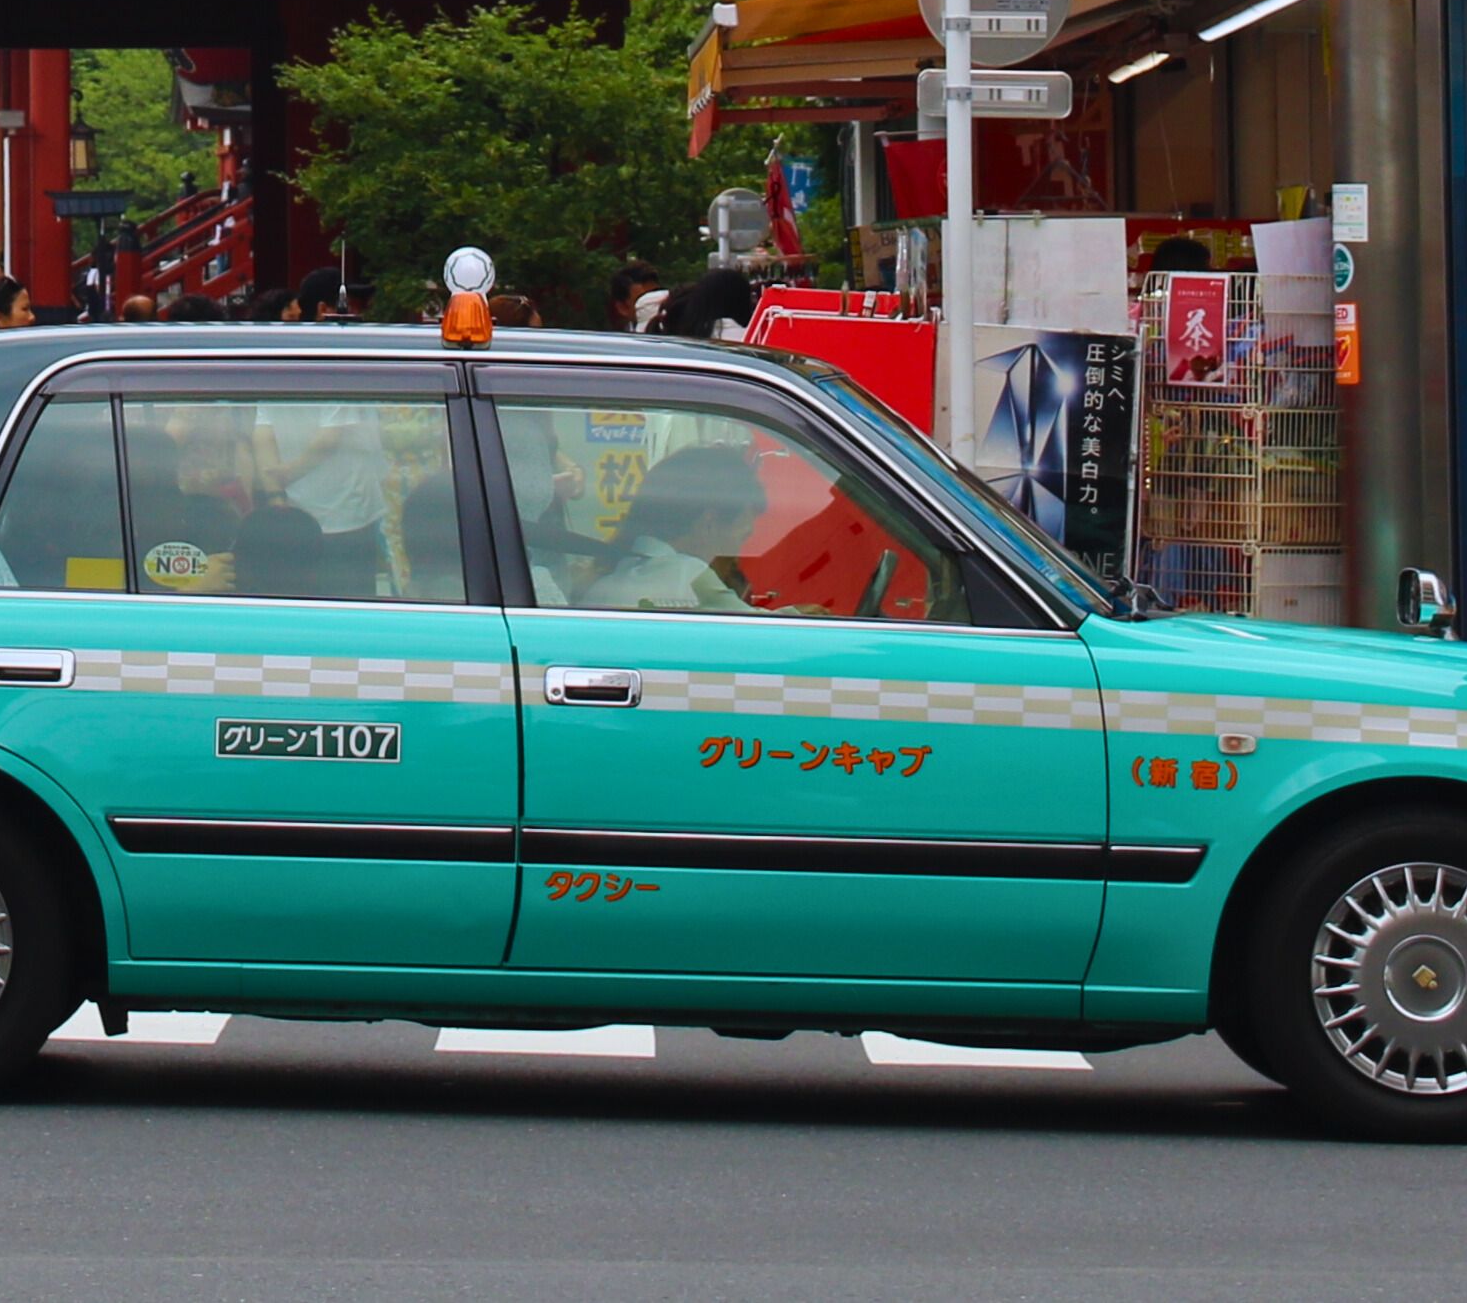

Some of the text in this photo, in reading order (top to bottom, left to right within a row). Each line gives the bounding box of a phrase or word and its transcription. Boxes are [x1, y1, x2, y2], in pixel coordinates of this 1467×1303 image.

[1079, 343, 1106, 515] 圧倒的な美白力。
[222, 723, 397, 761] グリーン1107
[698, 734, 933, 778] グリーンキャブ
[544, 870, 661, 902] タクシー
